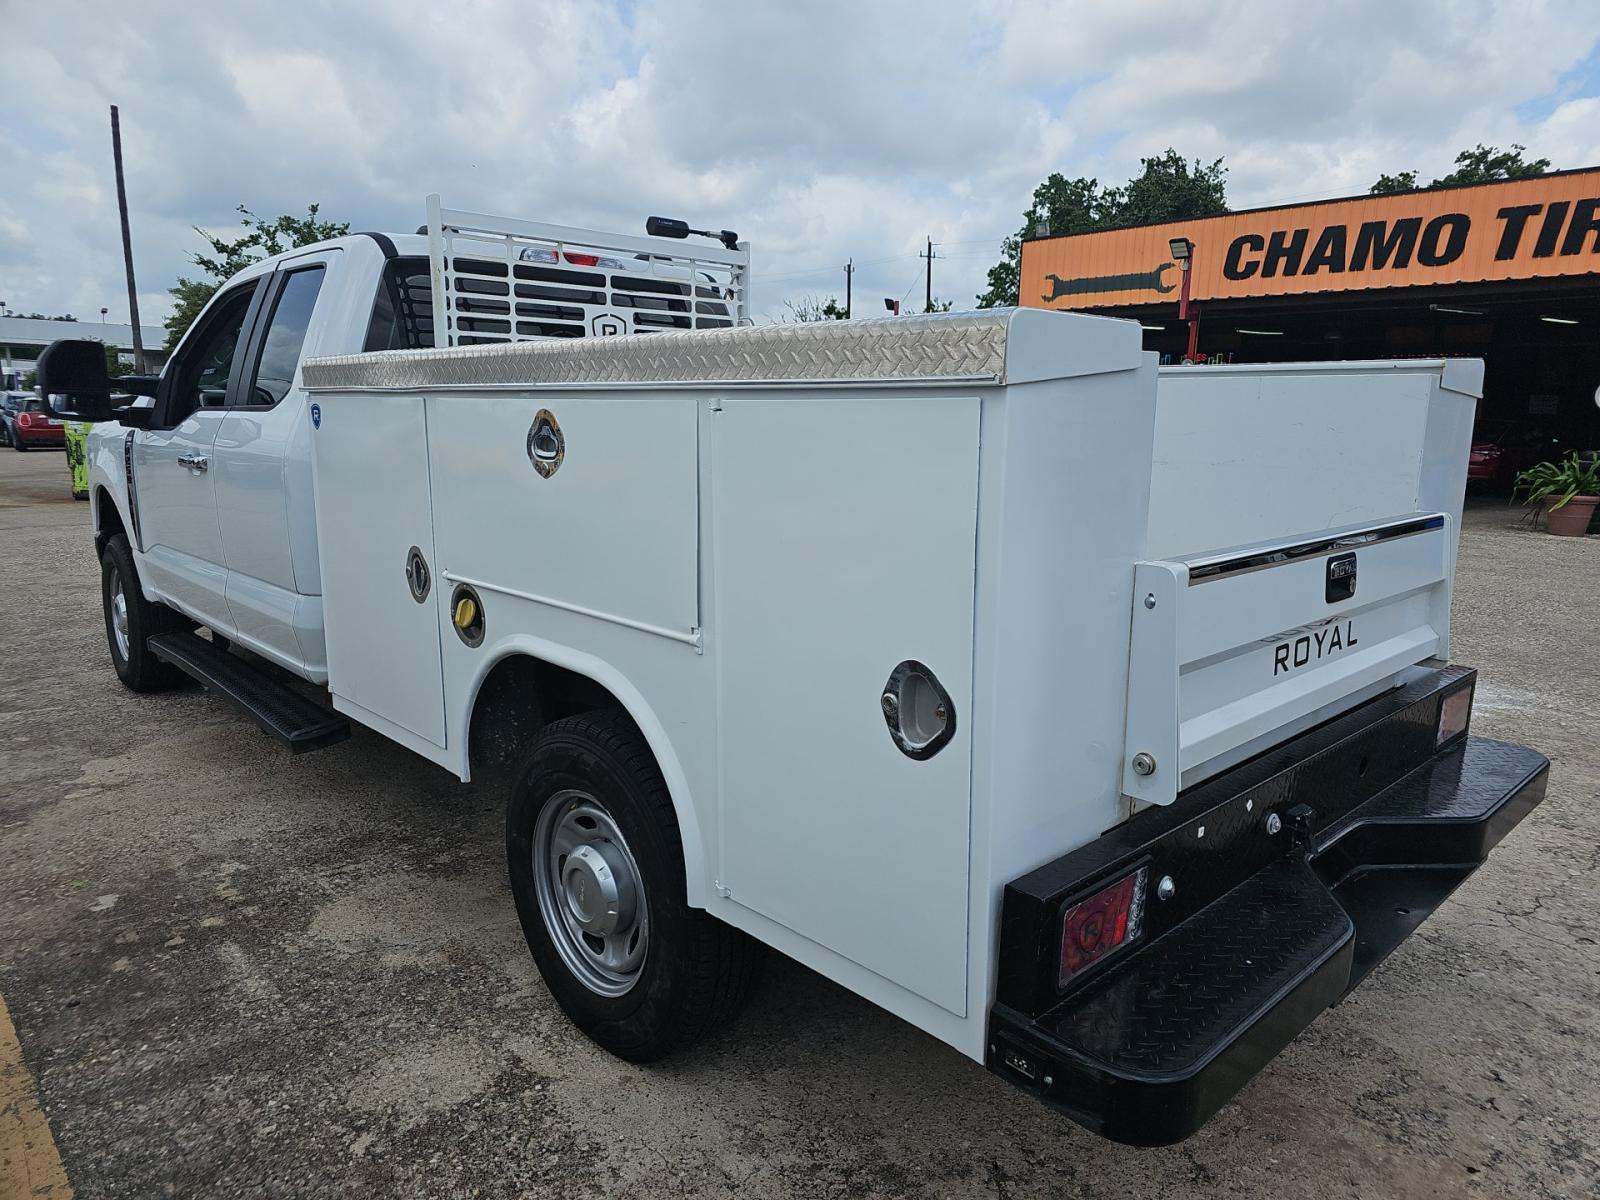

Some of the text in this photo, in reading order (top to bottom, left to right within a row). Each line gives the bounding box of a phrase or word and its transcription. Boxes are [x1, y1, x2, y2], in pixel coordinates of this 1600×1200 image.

[1223, 198, 1600, 281] CHAMO TIR
[1274, 620, 1358, 676] ROYAL
